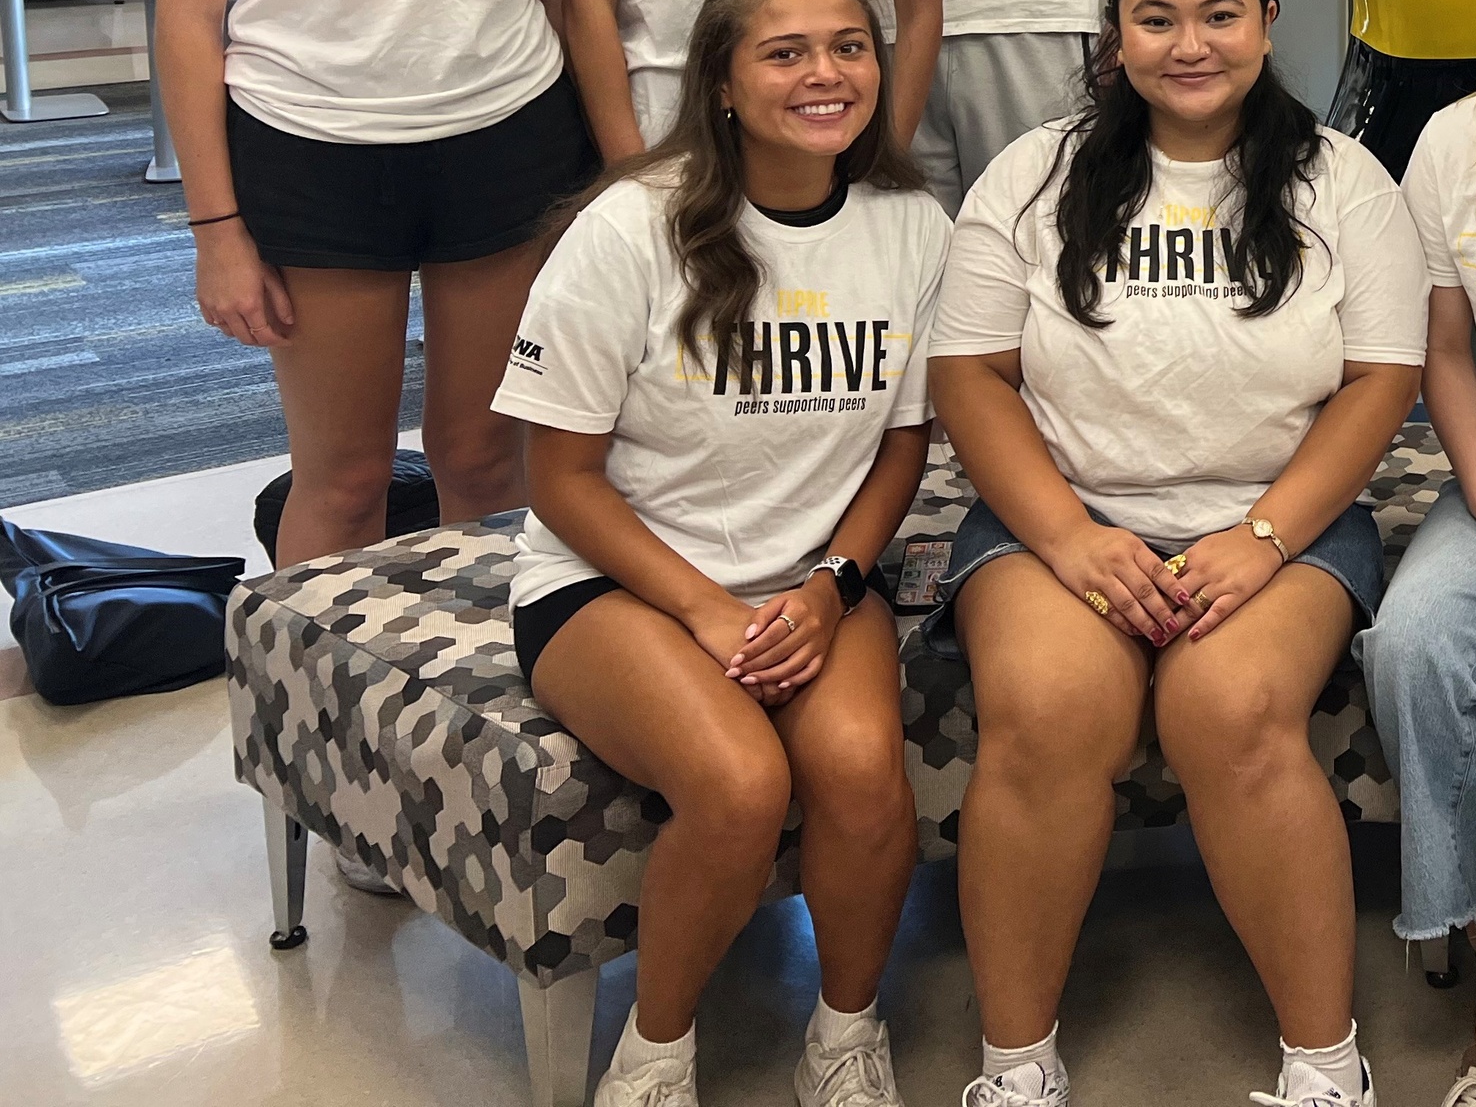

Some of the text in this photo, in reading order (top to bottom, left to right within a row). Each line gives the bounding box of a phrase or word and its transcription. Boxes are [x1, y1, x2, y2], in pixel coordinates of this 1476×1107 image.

[1126, 284, 1158, 298] peers
[712, 320, 889, 395] THRIVE
[734, 396, 866, 416] peers supporting peers
